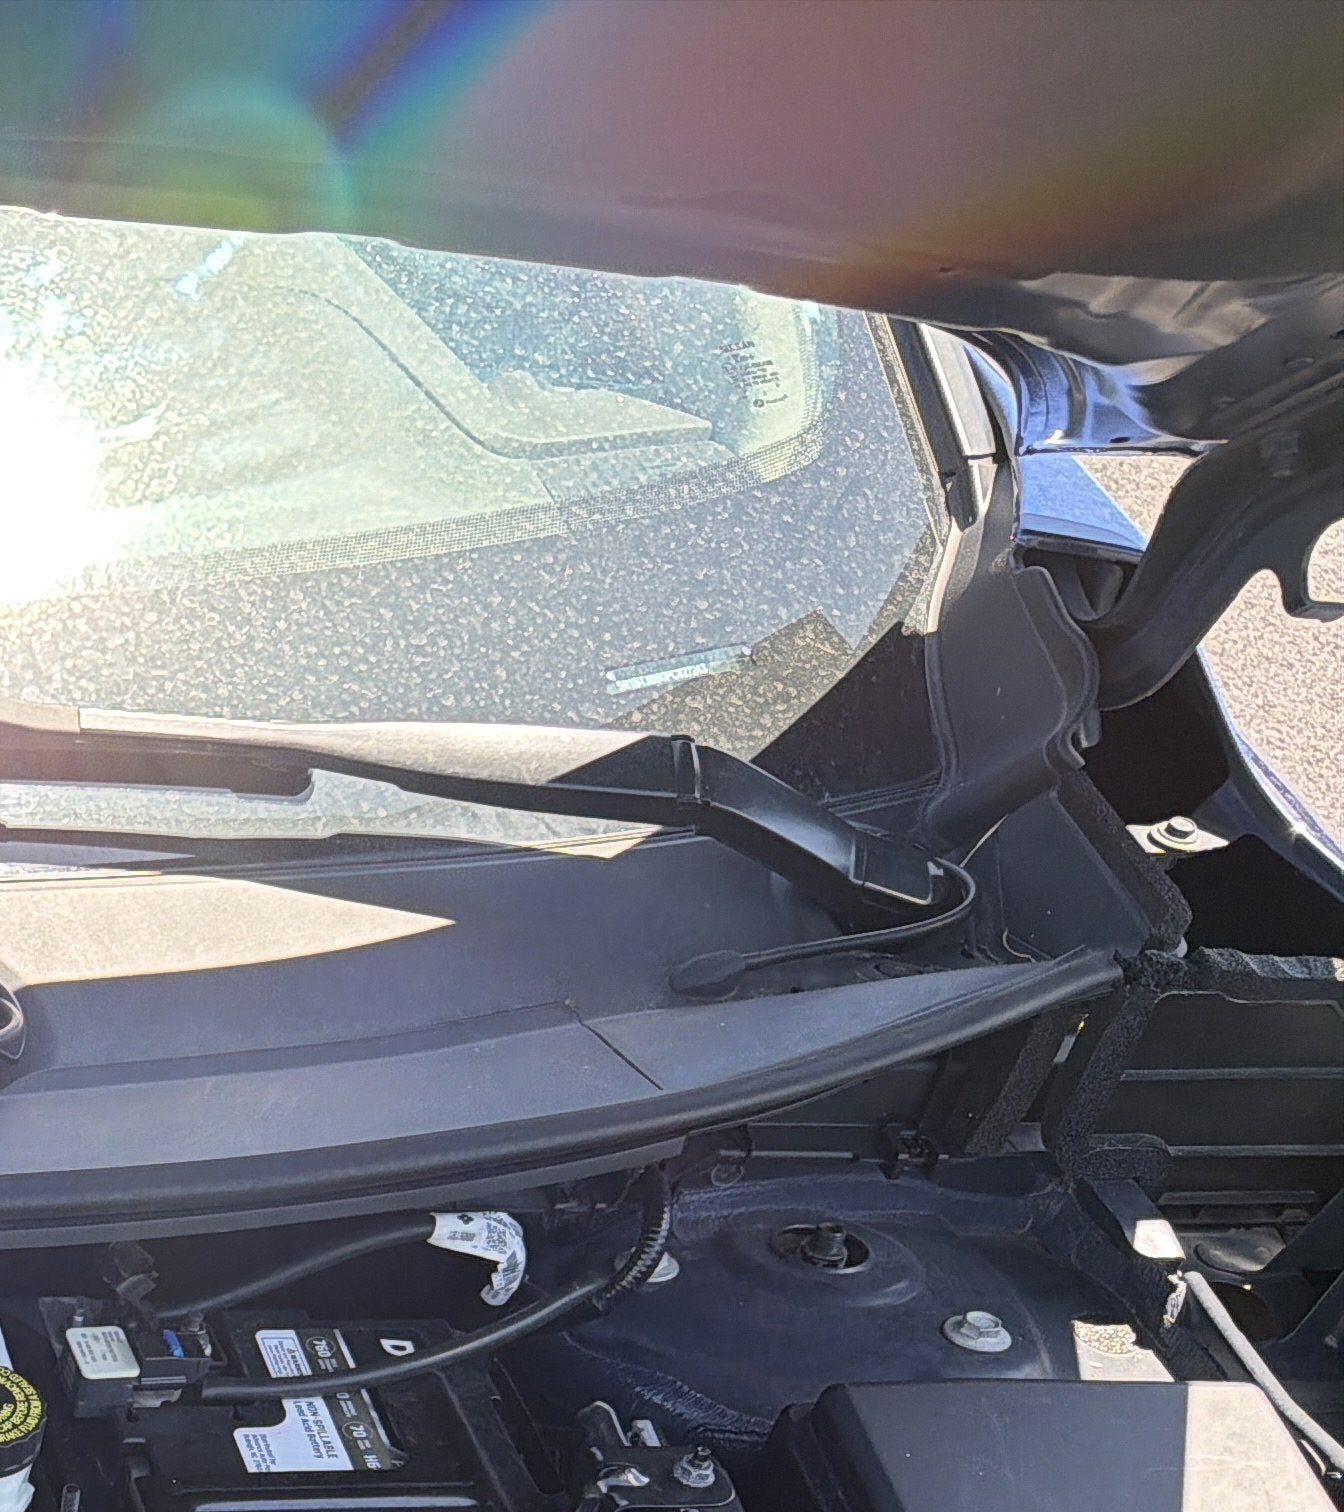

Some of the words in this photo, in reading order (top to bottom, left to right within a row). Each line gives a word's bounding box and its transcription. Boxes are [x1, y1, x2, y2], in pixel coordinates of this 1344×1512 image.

[313, 1340, 330, 1357] 760
[9, 1372, 37, 1397] SEALED
[301, 1418, 313, 1432] Acid
[305, 1401, 337, 1457] NON-SPILLABLE
[350, 1425, 366, 1437] 70
